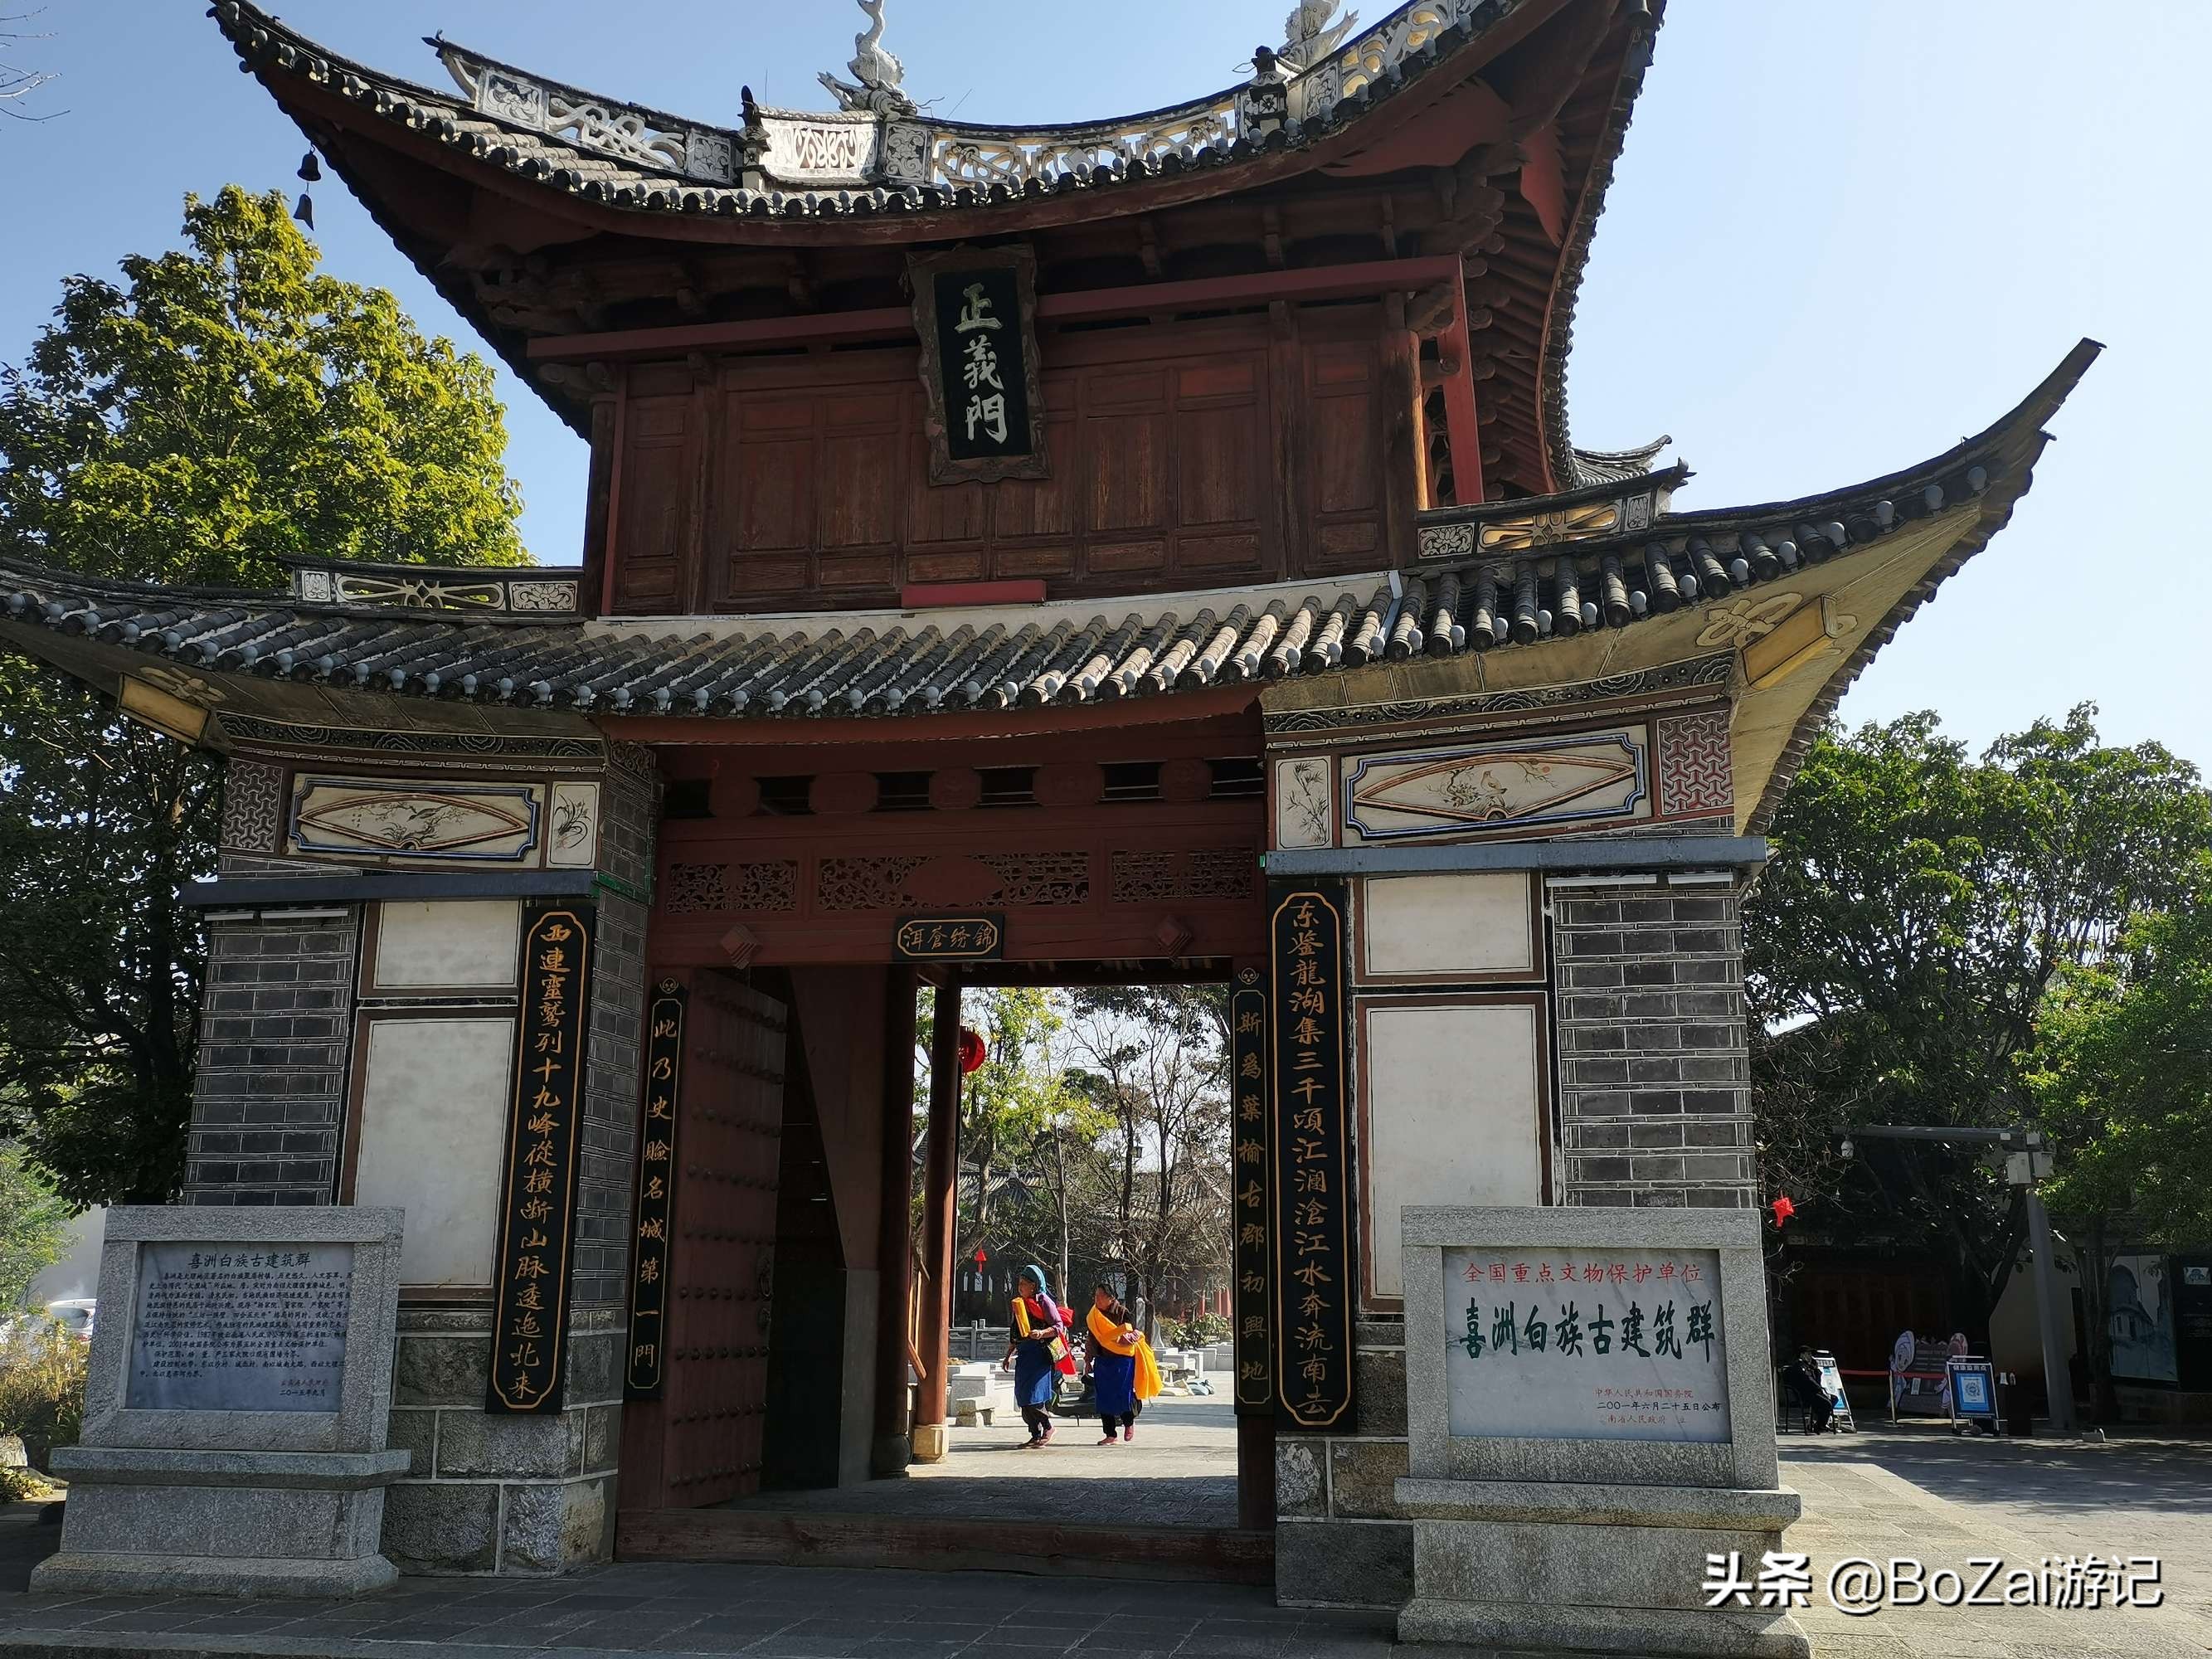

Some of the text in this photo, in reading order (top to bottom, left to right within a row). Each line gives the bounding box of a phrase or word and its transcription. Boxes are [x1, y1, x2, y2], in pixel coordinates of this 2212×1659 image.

[954, 282, 1008, 445] 正義門
[187, 1253, 312, 1270] 喜洲白族古建筑群
[1461, 1262, 1704, 1284] 全国重点文物保护单位
[1459, 1297, 1715, 1364] 喜洲白族古建筑群
[1594, 1388, 1694, 1399] 中华人民共和国国务院
